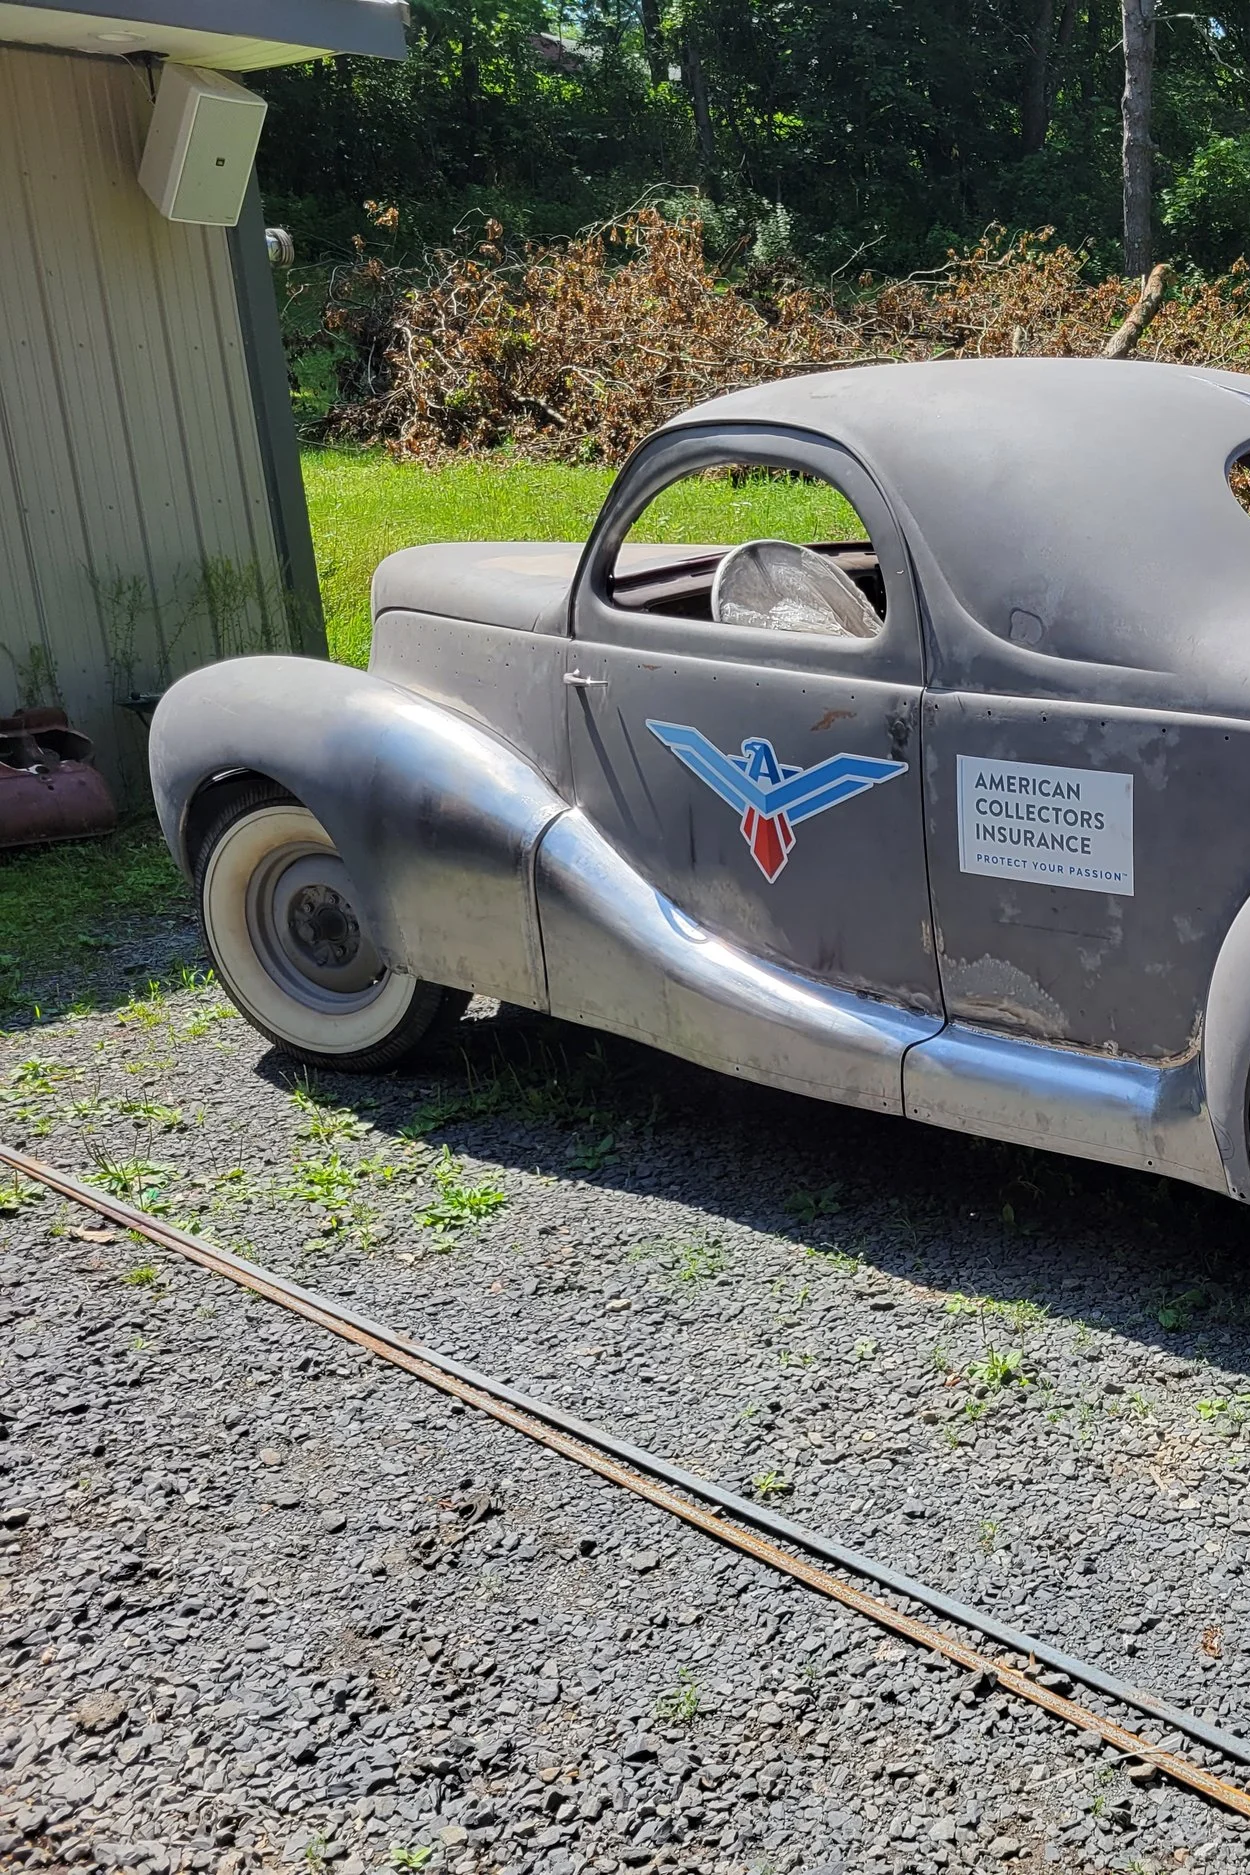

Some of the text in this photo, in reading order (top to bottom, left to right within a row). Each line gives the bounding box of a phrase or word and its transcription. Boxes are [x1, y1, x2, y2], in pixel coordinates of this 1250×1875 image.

[975, 772, 1081, 801] AMERICAN
[975, 798, 1105, 830] COLLECTORS
[975, 823, 1092, 855] INSURANCE
[977, 854, 1028, 869] PROTECT
[1032, 861, 1064, 874] YOUR
